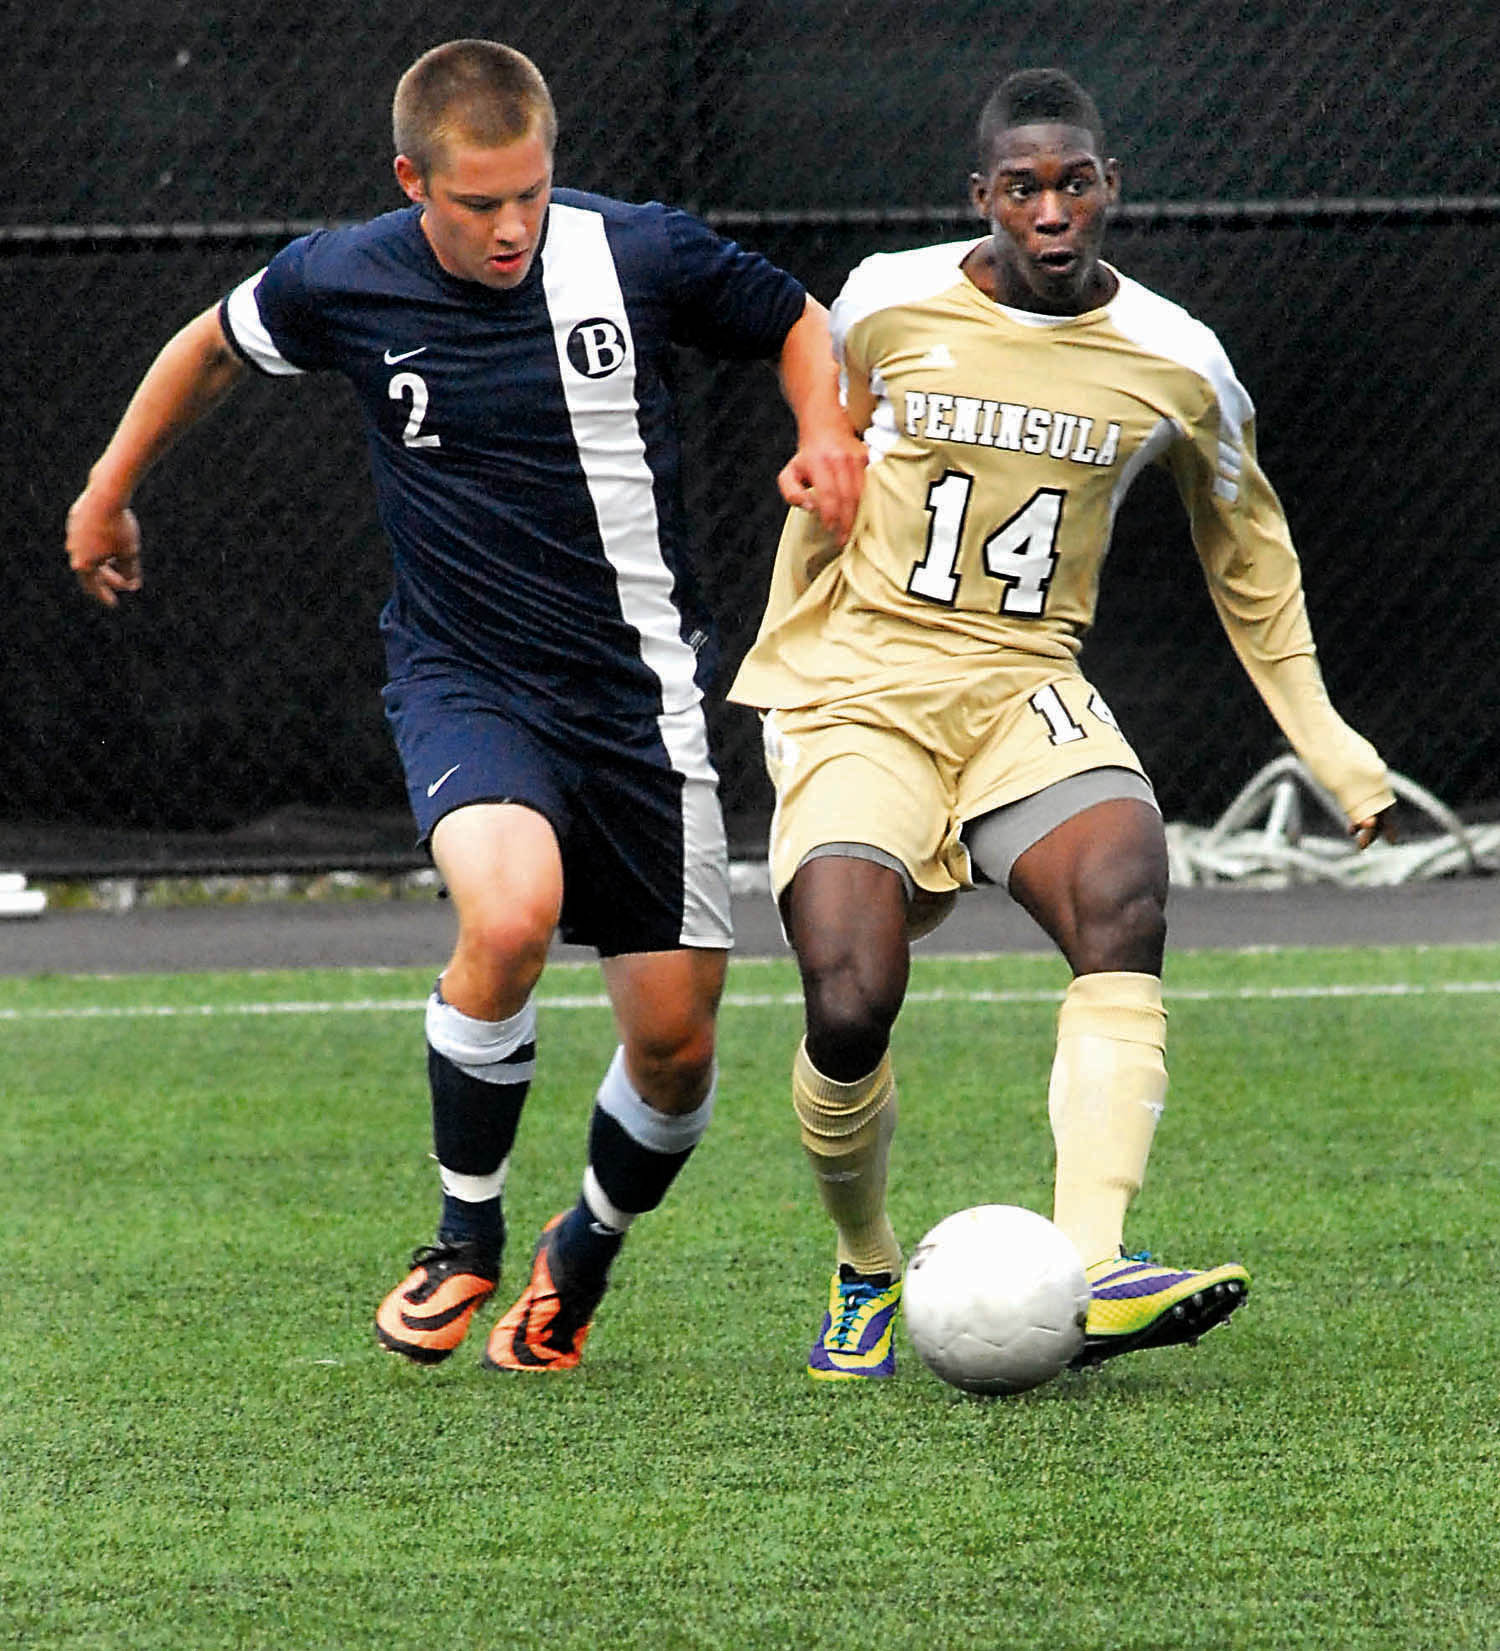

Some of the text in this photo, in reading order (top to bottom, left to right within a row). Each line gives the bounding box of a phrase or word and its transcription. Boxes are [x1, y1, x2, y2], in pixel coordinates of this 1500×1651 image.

[576, 323, 626, 375] B
[388, 372, 441, 447] 2
[905, 390, 1121, 466] PENINSULA
[906, 469, 1067, 618] 14
